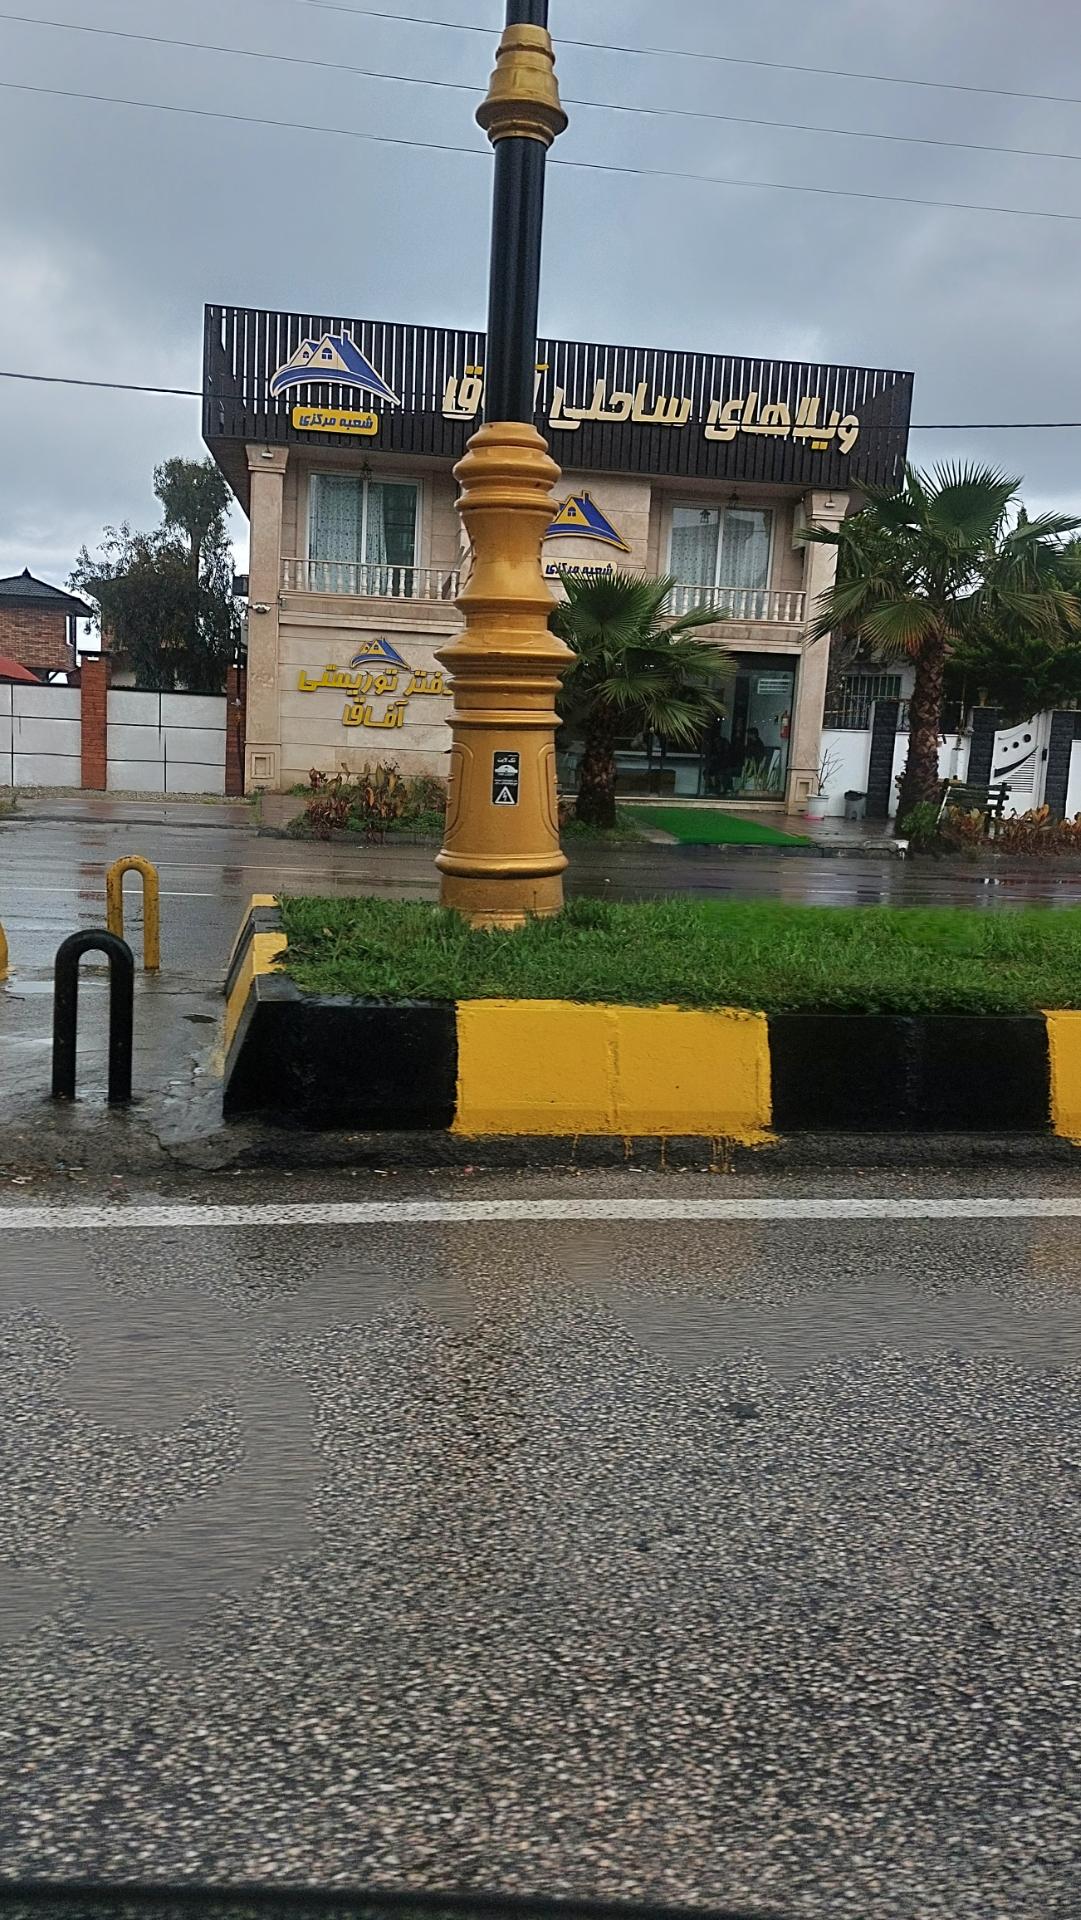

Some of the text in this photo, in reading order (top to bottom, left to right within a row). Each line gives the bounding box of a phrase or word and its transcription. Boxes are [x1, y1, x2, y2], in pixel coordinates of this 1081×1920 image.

[549, 378, 692, 431] ساحلی
[299, 413, 373, 430] شعبه مرکزی
[704, 391, 860, 455] ویلاهای
[298, 663, 398, 696] توریستی
[342, 696, 409, 729] آفاق
